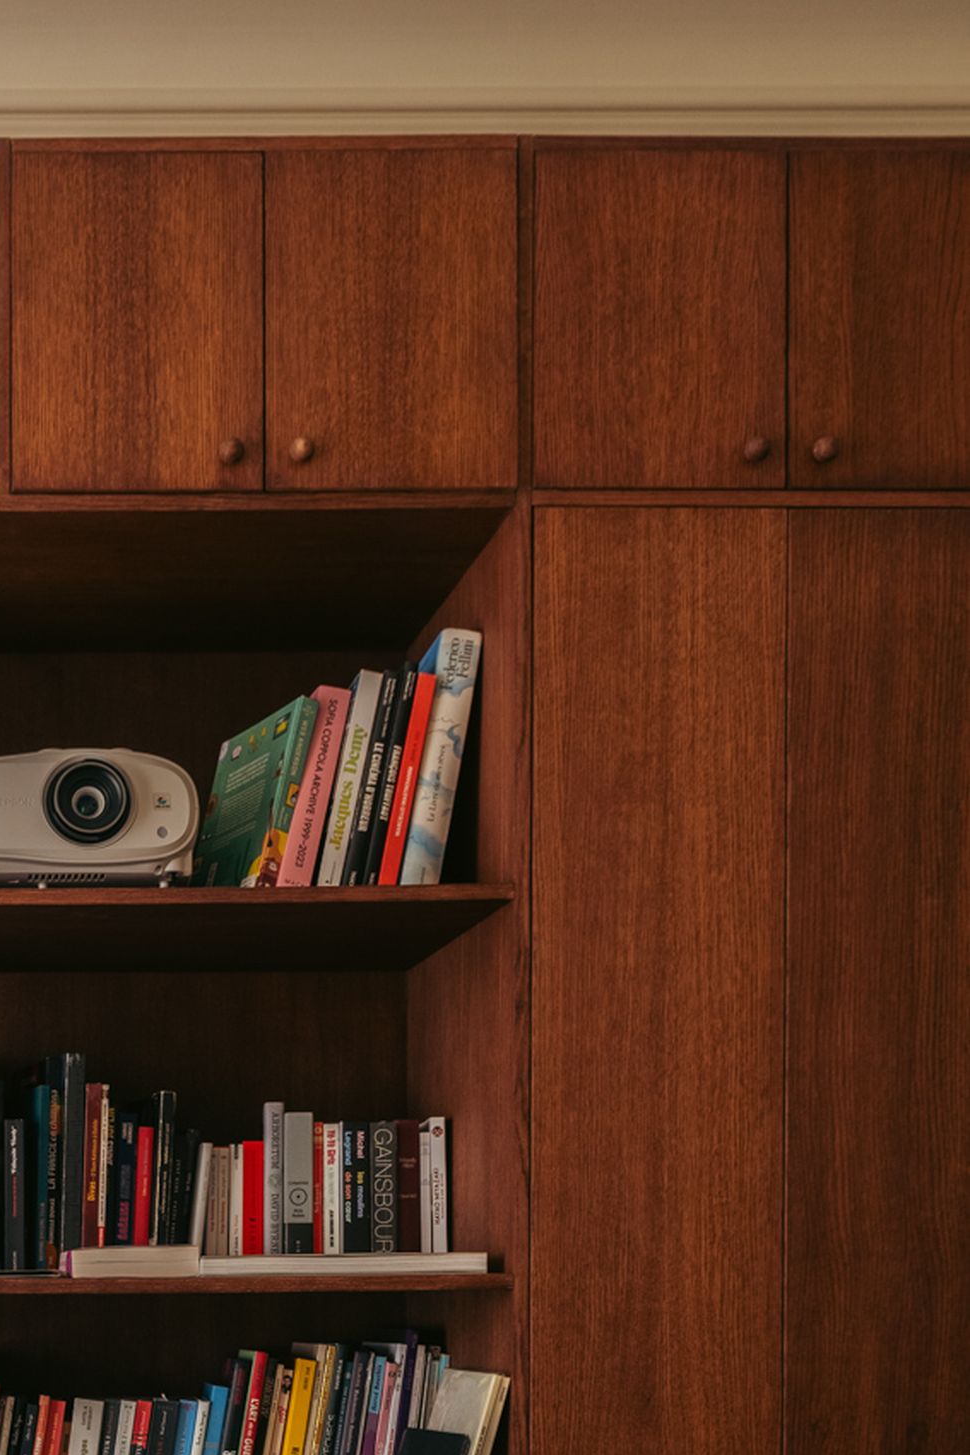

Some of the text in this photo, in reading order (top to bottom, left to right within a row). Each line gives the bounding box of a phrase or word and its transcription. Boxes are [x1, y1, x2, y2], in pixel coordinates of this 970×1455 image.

[438, 635, 462, 691] Federico
[455, 638, 474, 678] Fellini
[323, 697, 338, 726] SOFIA
[313, 726, 332, 773] COPPOLA
[372, 741, 384, 753] LE
[327, 722, 369, 851] Jacques Demy
[365, 752, 384, 786] CINÉMA
[304, 773, 322, 815] ARCHIVE
[343, 1130, 352, 1166] Legrand
[270, 1112, 279, 1254] ARBORETUM DAVID BYRNE
[344, 1170, 352, 1182] de
[356, 1130, 364, 1218] Michel les moulins
[246, 1397, 260, 1422] L'ART
